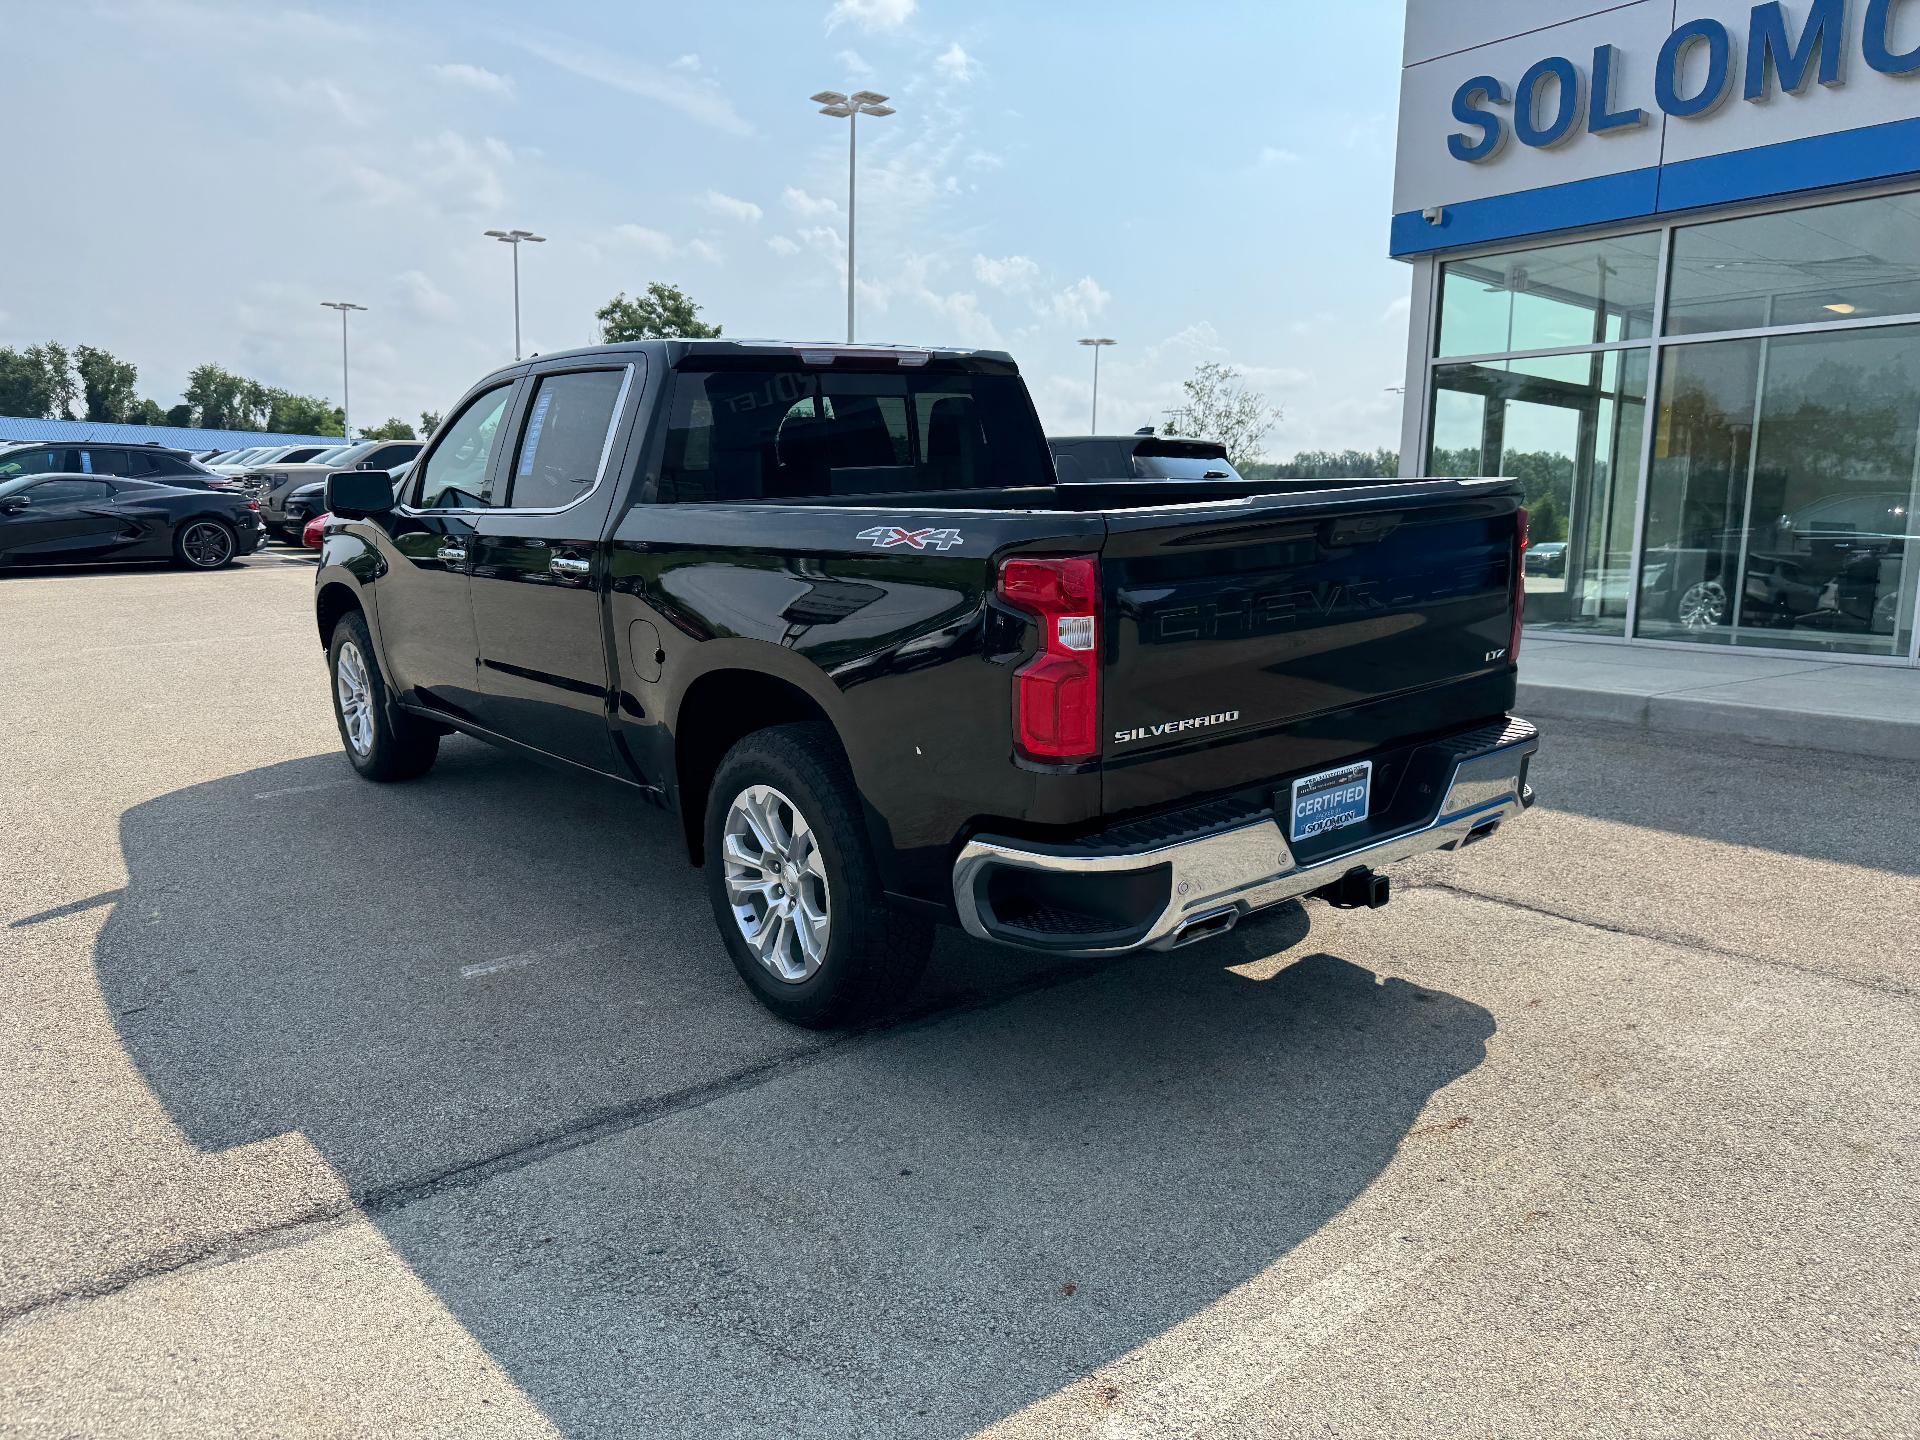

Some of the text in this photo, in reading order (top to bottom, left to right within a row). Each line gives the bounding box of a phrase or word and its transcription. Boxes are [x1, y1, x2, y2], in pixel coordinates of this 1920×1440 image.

[856, 526, 964, 550] 4X4
[1485, 648, 1506, 662] LTZ
[1114, 710, 1240, 743] SILVERADO
[1297, 786, 1364, 817] CERTIFIED
[1306, 811, 1354, 833] SOLOMON
